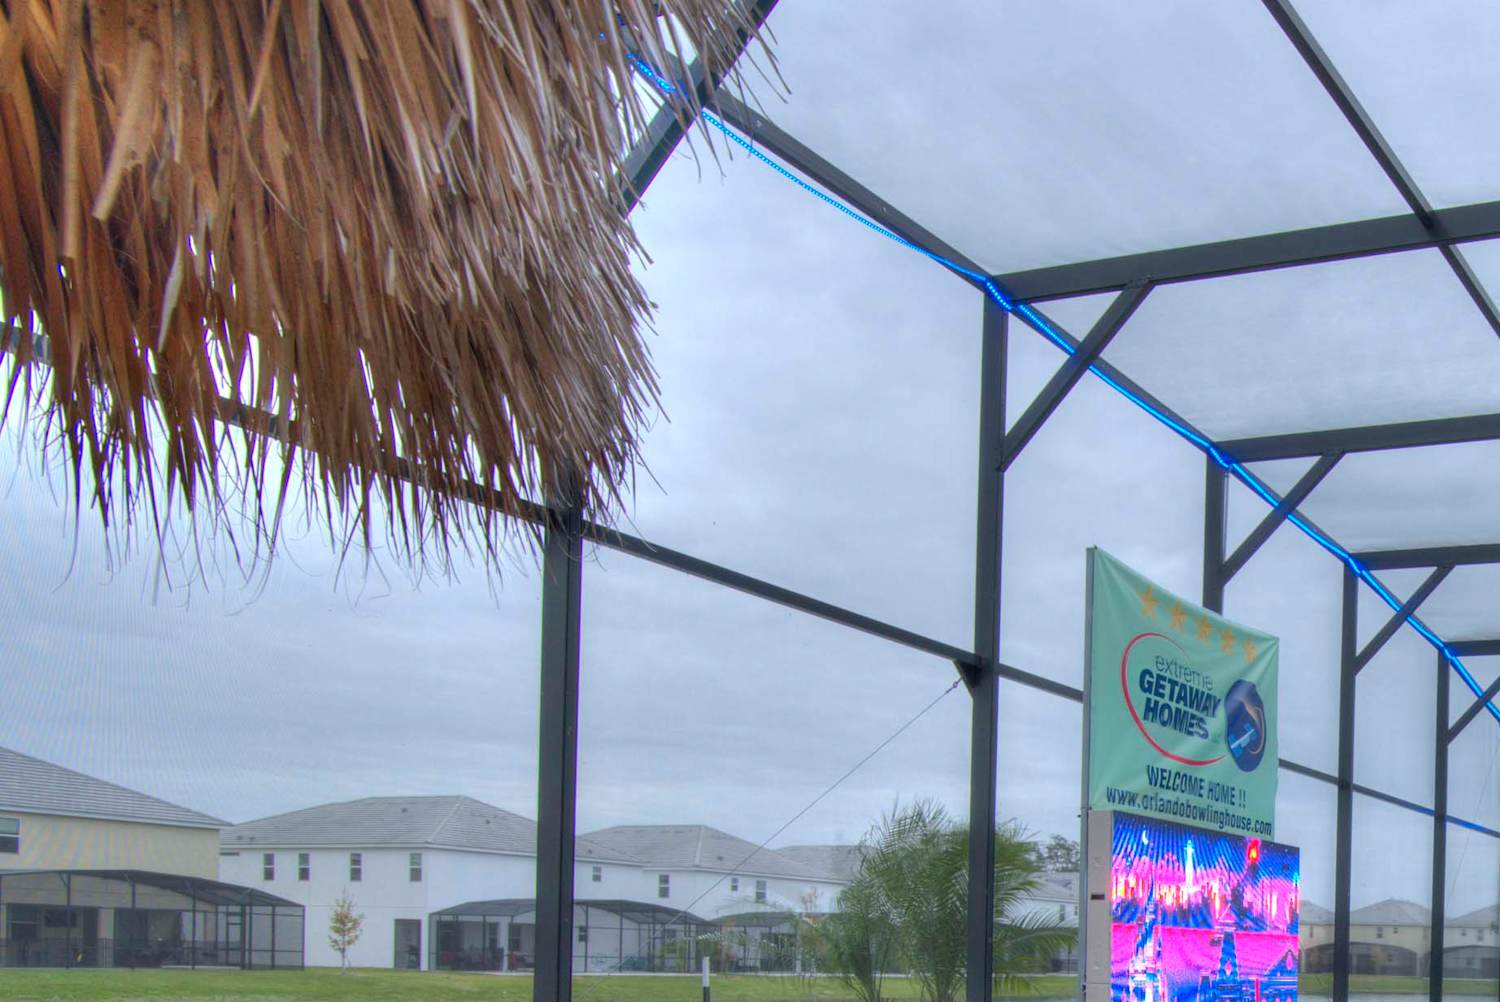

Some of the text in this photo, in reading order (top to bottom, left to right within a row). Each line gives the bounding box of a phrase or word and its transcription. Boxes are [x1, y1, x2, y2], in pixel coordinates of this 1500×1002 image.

[1139, 668, 1221, 718] GETAWAY
[1155, 655, 1213, 691] extreme
[1143, 697, 1209, 740] HOMES
[1147, 765, 1204, 798] WELCOME
[1208, 782, 1235, 808] HOME
[1106, 786, 1272, 836] www.orlandobowlinghouse.com
